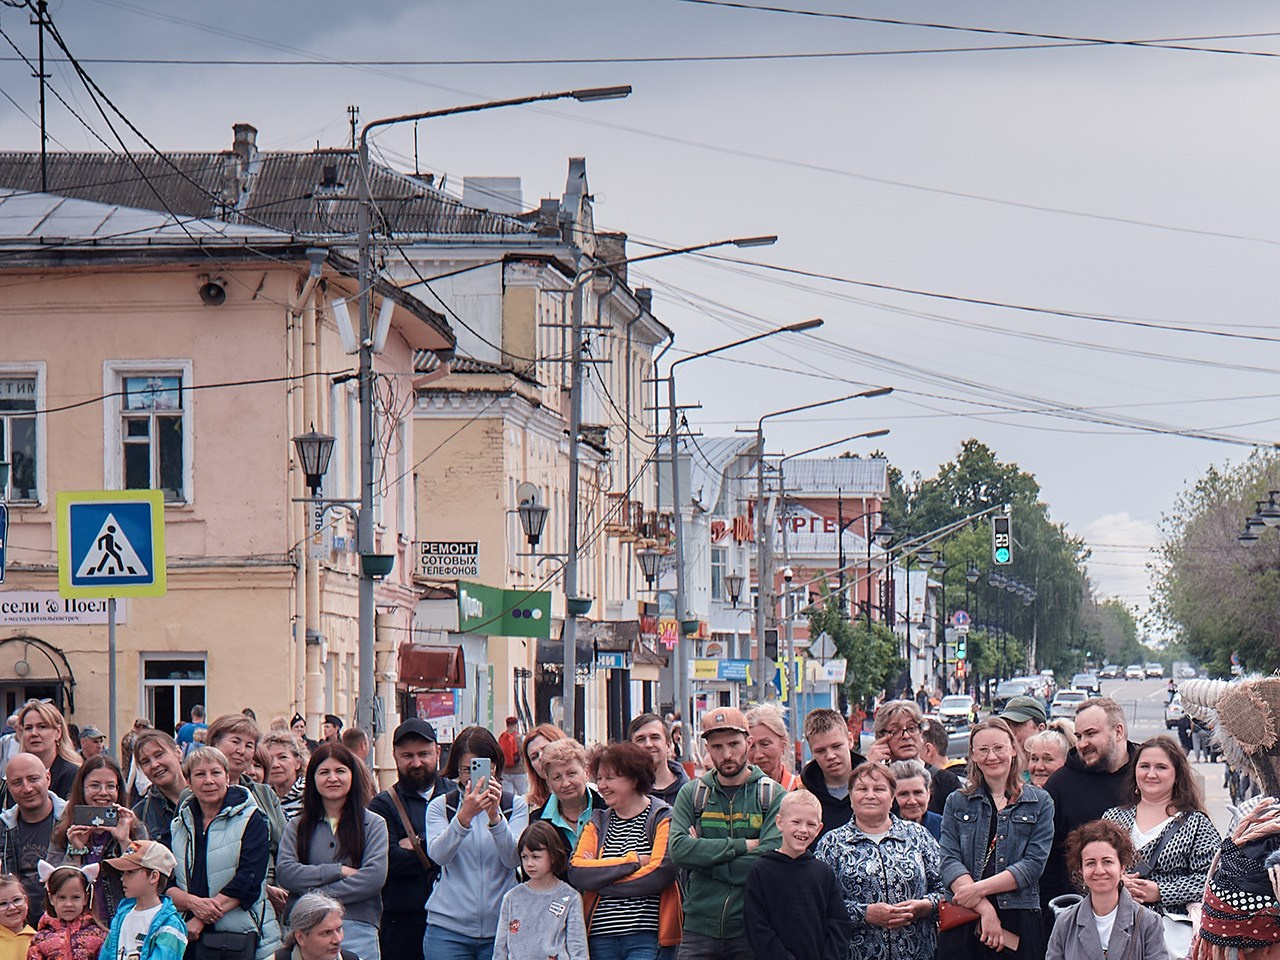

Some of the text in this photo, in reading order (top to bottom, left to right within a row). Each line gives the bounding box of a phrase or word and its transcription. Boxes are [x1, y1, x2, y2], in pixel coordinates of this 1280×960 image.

[996, 534, 1008, 547] 23
[422, 543, 477, 554] РЕМОНТ
[421, 555, 477, 565] СОТОВЫХ
[421, 566, 478, 575] ТЕЛЕФОНОВ
[0, 601, 40, 614] сели
[65, 599, 117, 614] Поел
